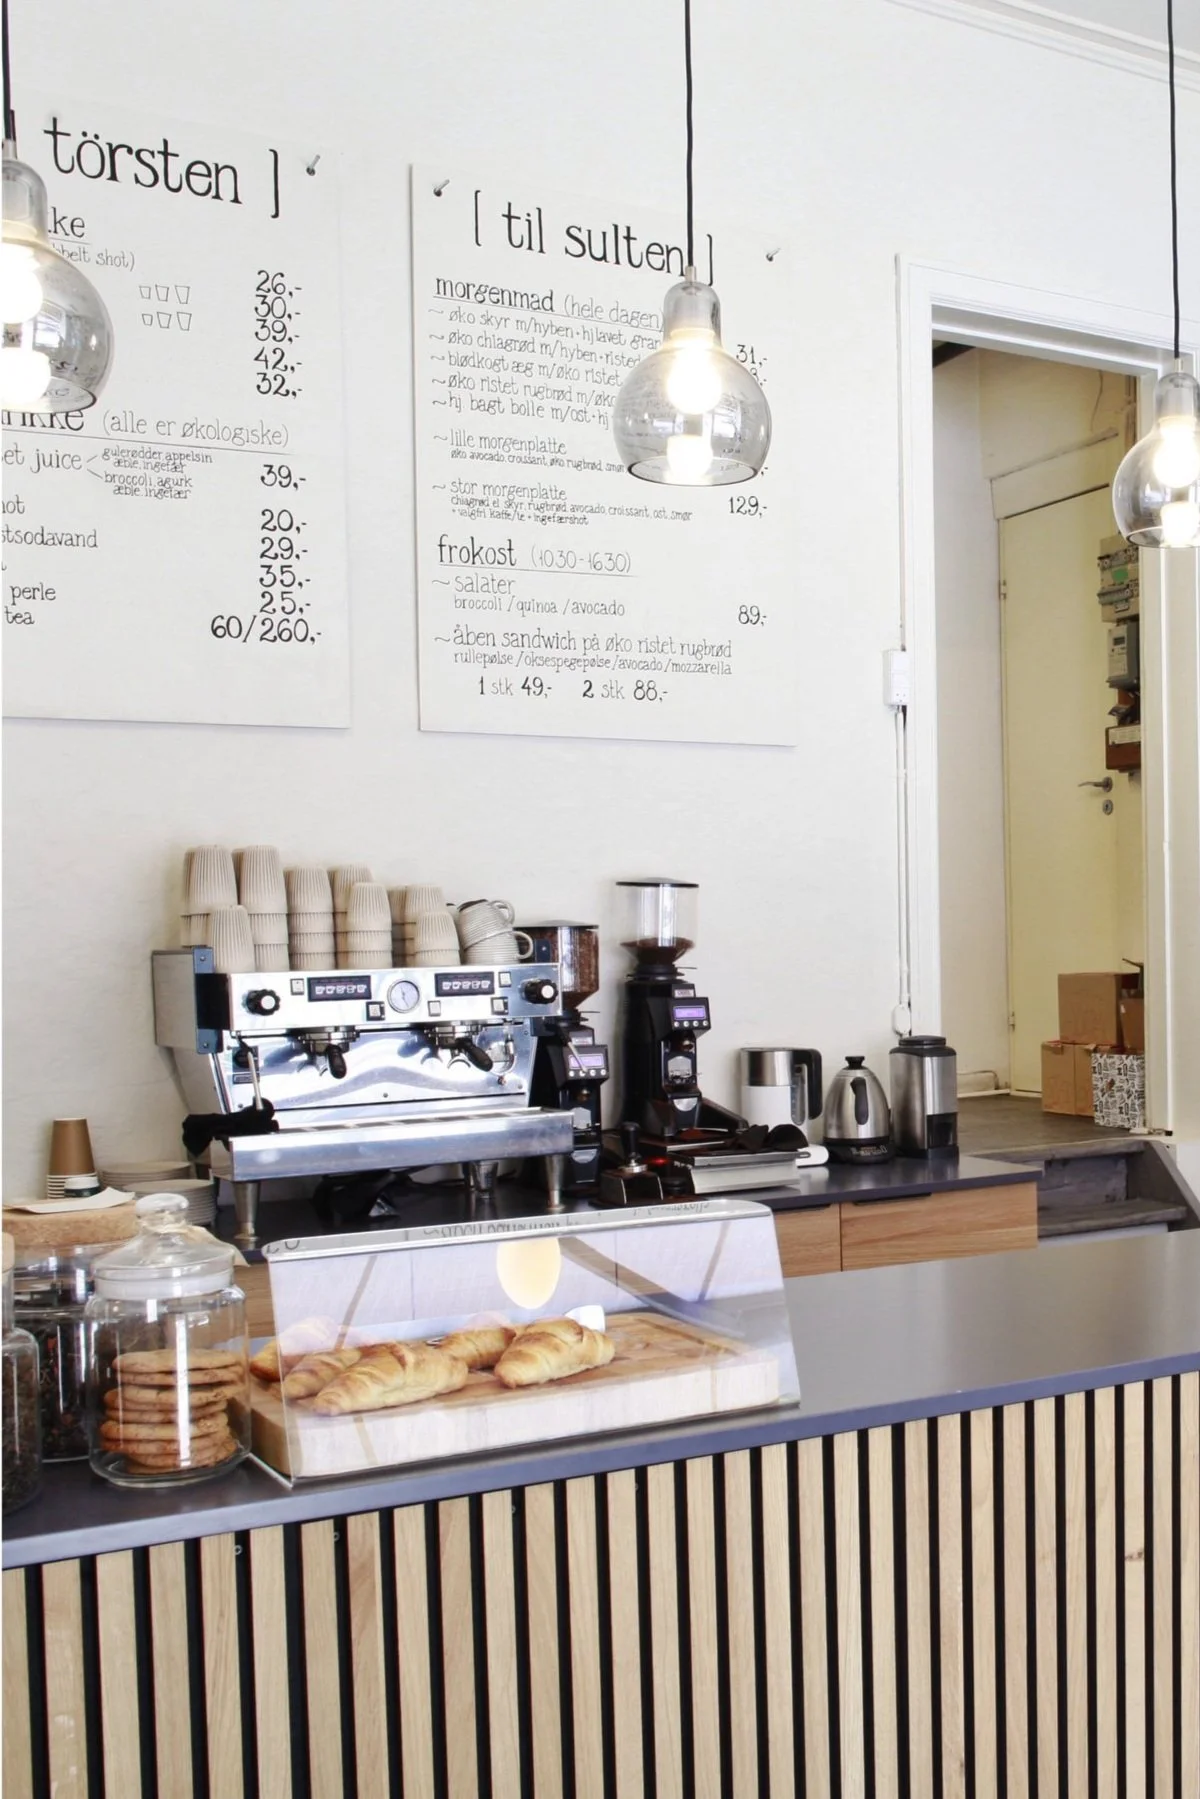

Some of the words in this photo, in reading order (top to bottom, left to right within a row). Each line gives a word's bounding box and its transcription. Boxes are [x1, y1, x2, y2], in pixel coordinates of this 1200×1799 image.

[43, 116, 243, 205] törsten
[48, 206, 85, 238] ke
[501, 201, 546, 254] til
[564, 222, 686, 277] sulten
[96, 248, 135, 272] shot)
[256, 270, 302, 297] 26,-
[254, 295, 301, 321] 30,-
[436, 277, 555, 312] morgenmad
[564, 294, 604, 319] (hele
[448, 305, 476, 324] øko
[480, 309, 511, 329] skyr
[254, 318, 300, 344] 39,-
[448, 328, 473, 346] øko
[477, 330, 536, 353] chiagrød
[253, 347, 302, 373] 42,-
[448, 350, 509, 373] blødkogt
[511, 360, 534, 379] æg
[538, 362, 580, 381] m/øko
[585, 367, 624, 387] ristet
[736, 344, 768, 368] 31,-
[255, 373, 302, 399] 32,-
[447, 371, 476, 390] øko
[480, 375, 519, 395] ristet
[523, 383, 573, 402] rugbrød
[469, 392, 505, 415] bagt
[510, 397, 545, 418] bolle
[103, 410, 147, 435] (alle
[156, 420, 176, 436] er
[182, 417, 289, 448] økologiske)
[450, 428, 476, 448] lille
[479, 434, 567, 457] morgenplatte
[450, 447, 467, 459] øko
[2, 442, 25, 465] et
[30, 448, 82, 474] juice
[143, 459, 186, 474] ingefær
[165, 451, 213, 466] appelsin
[157, 475, 193, 490] agurk
[260, 464, 306, 490] 39,-
[450, 477, 478, 495] stor
[482, 482, 567, 502] morgenplatte
[144, 487, 192, 500] ingefær
[450, 494, 490, 509] chiagrød
[670, 510, 693, 521] smør
[533, 512, 589, 526] ingefærshot
[728, 495, 768, 519] 129,-
[260, 509, 307, 533] 20,-
[259, 537, 308, 560] 29,-
[437, 533, 517, 567] frokost
[259, 565, 311, 589] 35,-
[454, 572, 516, 594] salater
[10, 582, 56, 605] perle
[259, 591, 311, 615] 25,-
[454, 594, 502, 611] broccoli
[4, 606, 35, 625] tea
[738, 604, 767, 626] 89,-
[210, 615, 322, 645] 60/260,-
[453, 623, 496, 647] åben
[501, 627, 577, 651] sandwich
[582, 633, 600, 656] på
[605, 632, 633, 652] øko
[637, 634, 676, 655] ristet
[679, 637, 732, 660] rugbrød
[454, 649, 513, 668] rullepølse
[478, 675, 485, 695] 1
[490, 677, 514, 696] stk
[521, 676, 552, 699] 49,-
[582, 679, 595, 699] 2
[601, 679, 625, 700] stk
[633, 679, 668, 702] 88,-
